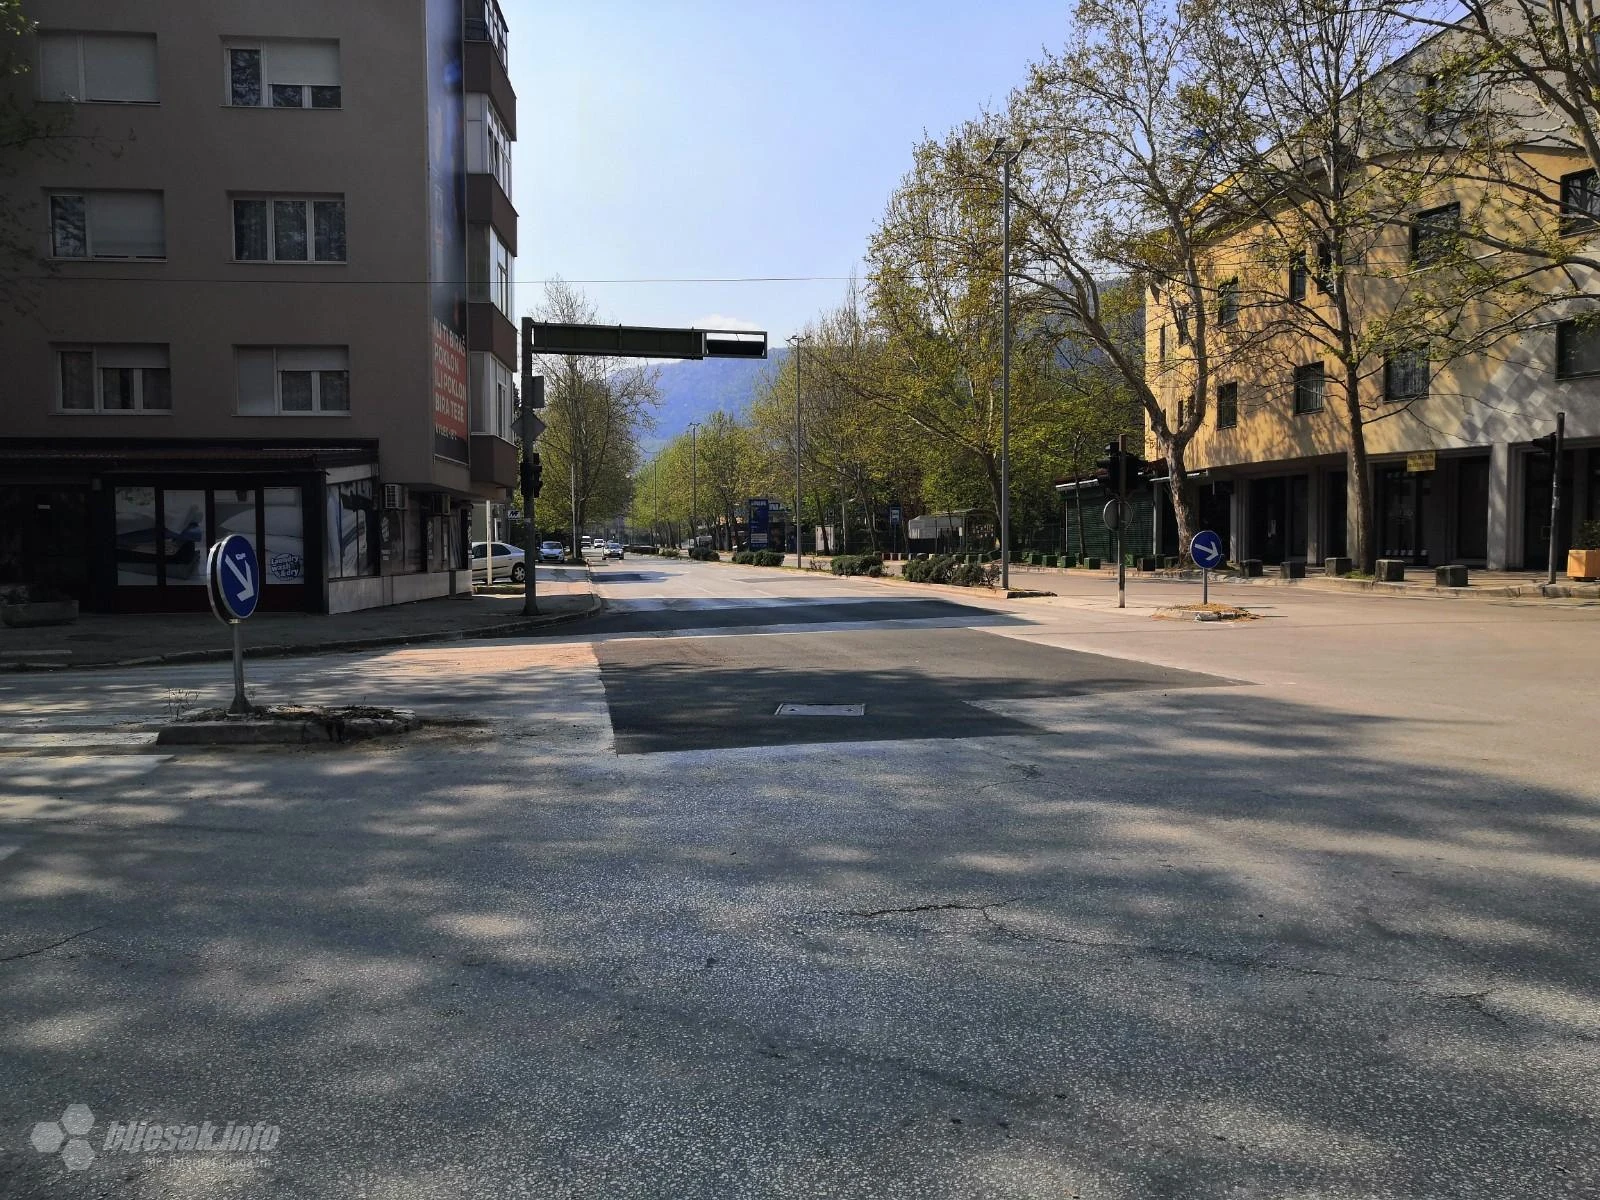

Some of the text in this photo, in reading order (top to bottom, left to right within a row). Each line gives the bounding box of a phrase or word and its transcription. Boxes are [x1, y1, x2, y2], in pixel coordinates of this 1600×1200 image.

[434, 342, 459, 375] POKLON
[444, 375, 467, 402] POKLON
[435, 391, 450, 417] BIRA
